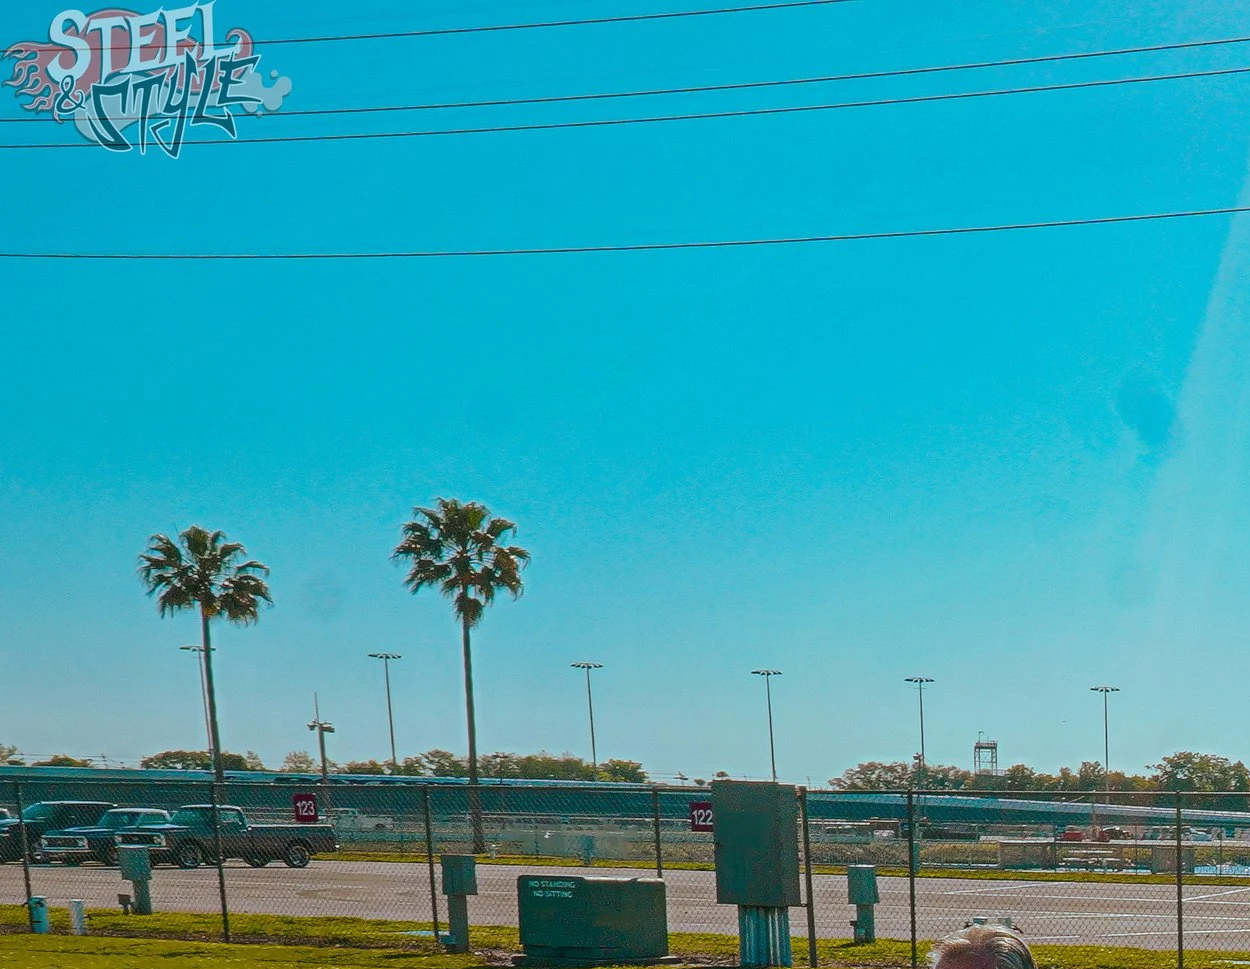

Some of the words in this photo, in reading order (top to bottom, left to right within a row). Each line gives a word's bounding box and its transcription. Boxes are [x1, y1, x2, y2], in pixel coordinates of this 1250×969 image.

[296, 800, 315, 816] 123
[692, 809, 714, 825] 122
[528, 880, 540, 888] NO
